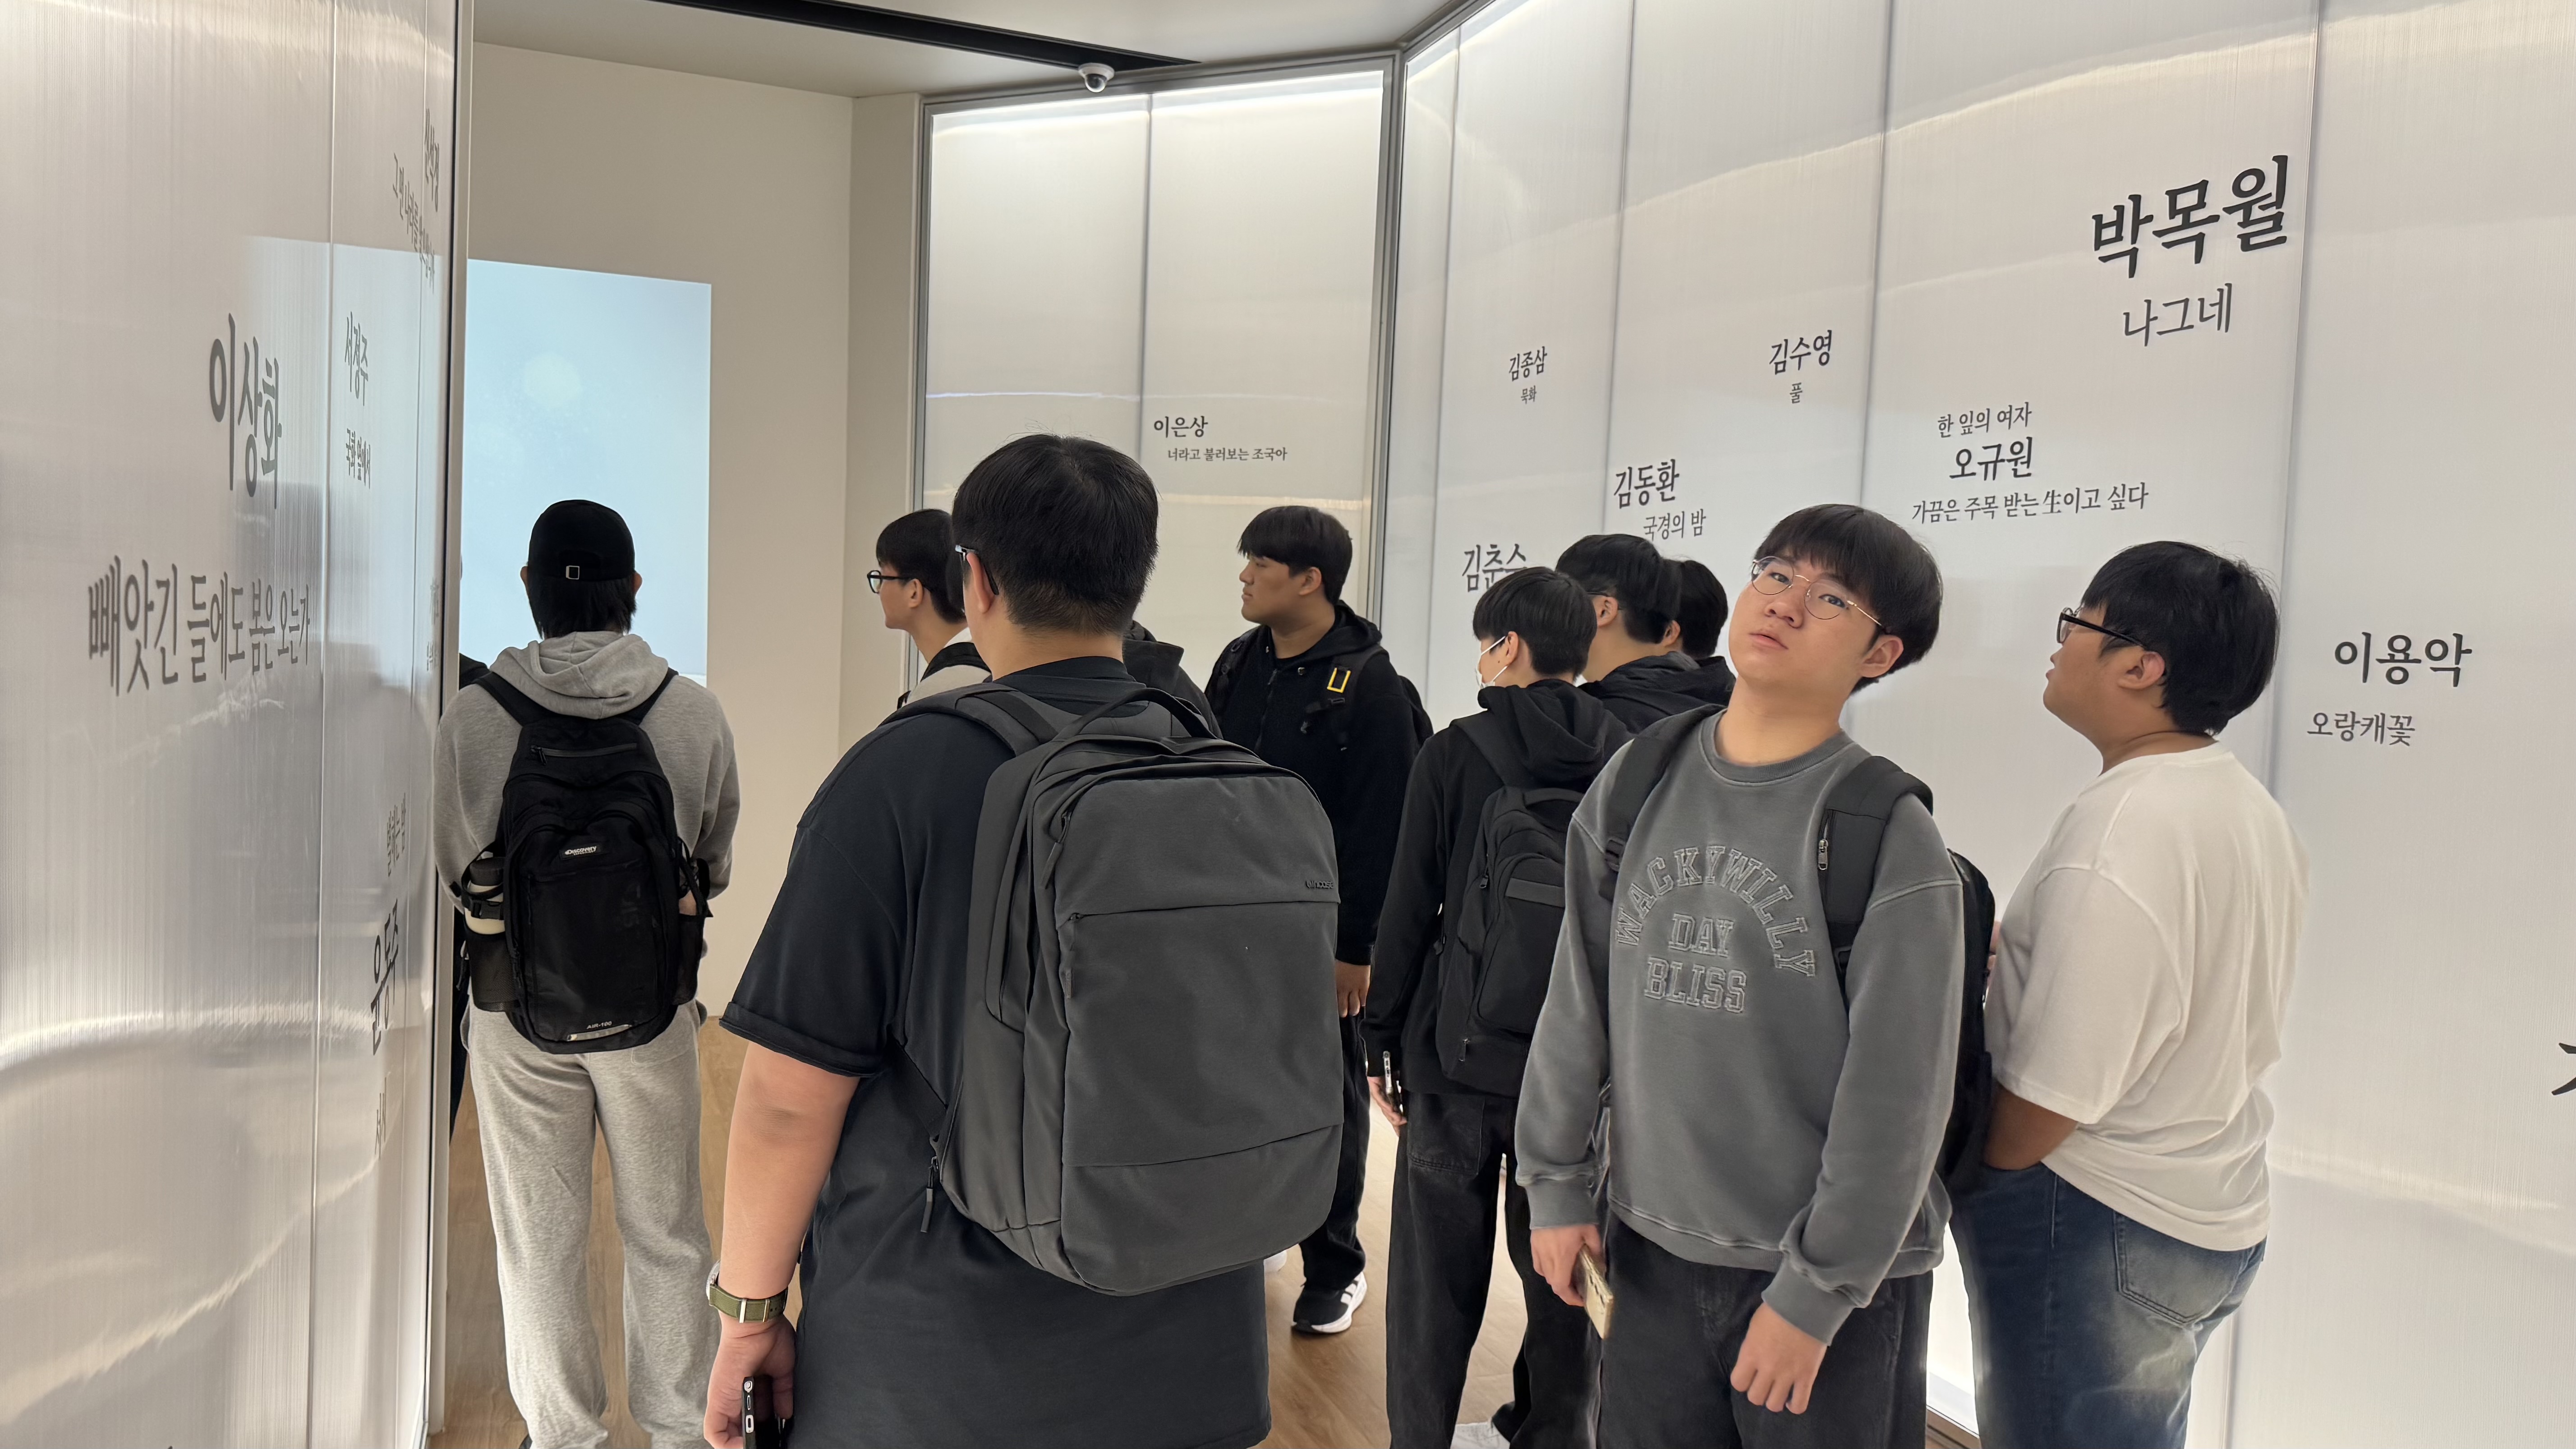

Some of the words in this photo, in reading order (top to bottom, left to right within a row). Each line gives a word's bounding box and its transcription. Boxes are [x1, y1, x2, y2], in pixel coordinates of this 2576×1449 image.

[393, 153, 398, 198] 그
[399, 167, 404, 221] 먼
[2092, 155, 2288, 279] 박목월
[2123, 283, 2232, 347] 나그네
[345, 311, 368, 406] 서정주
[1509, 346, 1547, 382] 김종삼
[1769, 329, 1832, 375] 김수영
[209, 313, 282, 510] 이상화
[1521, 385, 1537, 404] 묵화
[1789, 382, 1803, 404] 풀
[1154, 415, 1208, 438] 이은상
[1937, 414, 1954, 438] 한
[1959, 408, 1990, 436] 잎의
[1997, 401, 2032, 430] 여자
[345, 428, 356, 478] 국화
[357, 437, 371, 489] 앞에서
[1168, 448, 1201, 461] 너라고
[1204, 447, 1249, 461] 불러보는
[1252, 447, 1288, 461] 조국아
[1950, 437, 2033, 481] 오규원
[1614, 459, 1680, 509] 김동환
[1912, 499, 1960, 524] 가끔은
[1964, 495, 1999, 520] 주목
[2004, 492, 2039, 517] 받는
[2107, 482, 2149, 511] 싶다
[1643, 511, 1685, 541] 국경의
[1691, 508, 1707, 537] 밤
[88, 555, 179, 696] 빼앗긴
[187, 571, 245, 683] 들에도
[249, 578, 275, 676] 봄은
[277, 584, 310, 665] 오는가
[2335, 632, 2472, 687] 이용악
[2307, 711, 2415, 746] 오랑캐꽃
[1615, 846, 1815, 977] WACKYWILLY
[1669, 913, 1734, 957] DAY
[371, 898, 399, 1055] 윤동주
[1644, 956, 1746, 1013] BLISS
[586, 1021, 612, 1029] AIR-100
[375, 1076, 387, 1160] 서시
